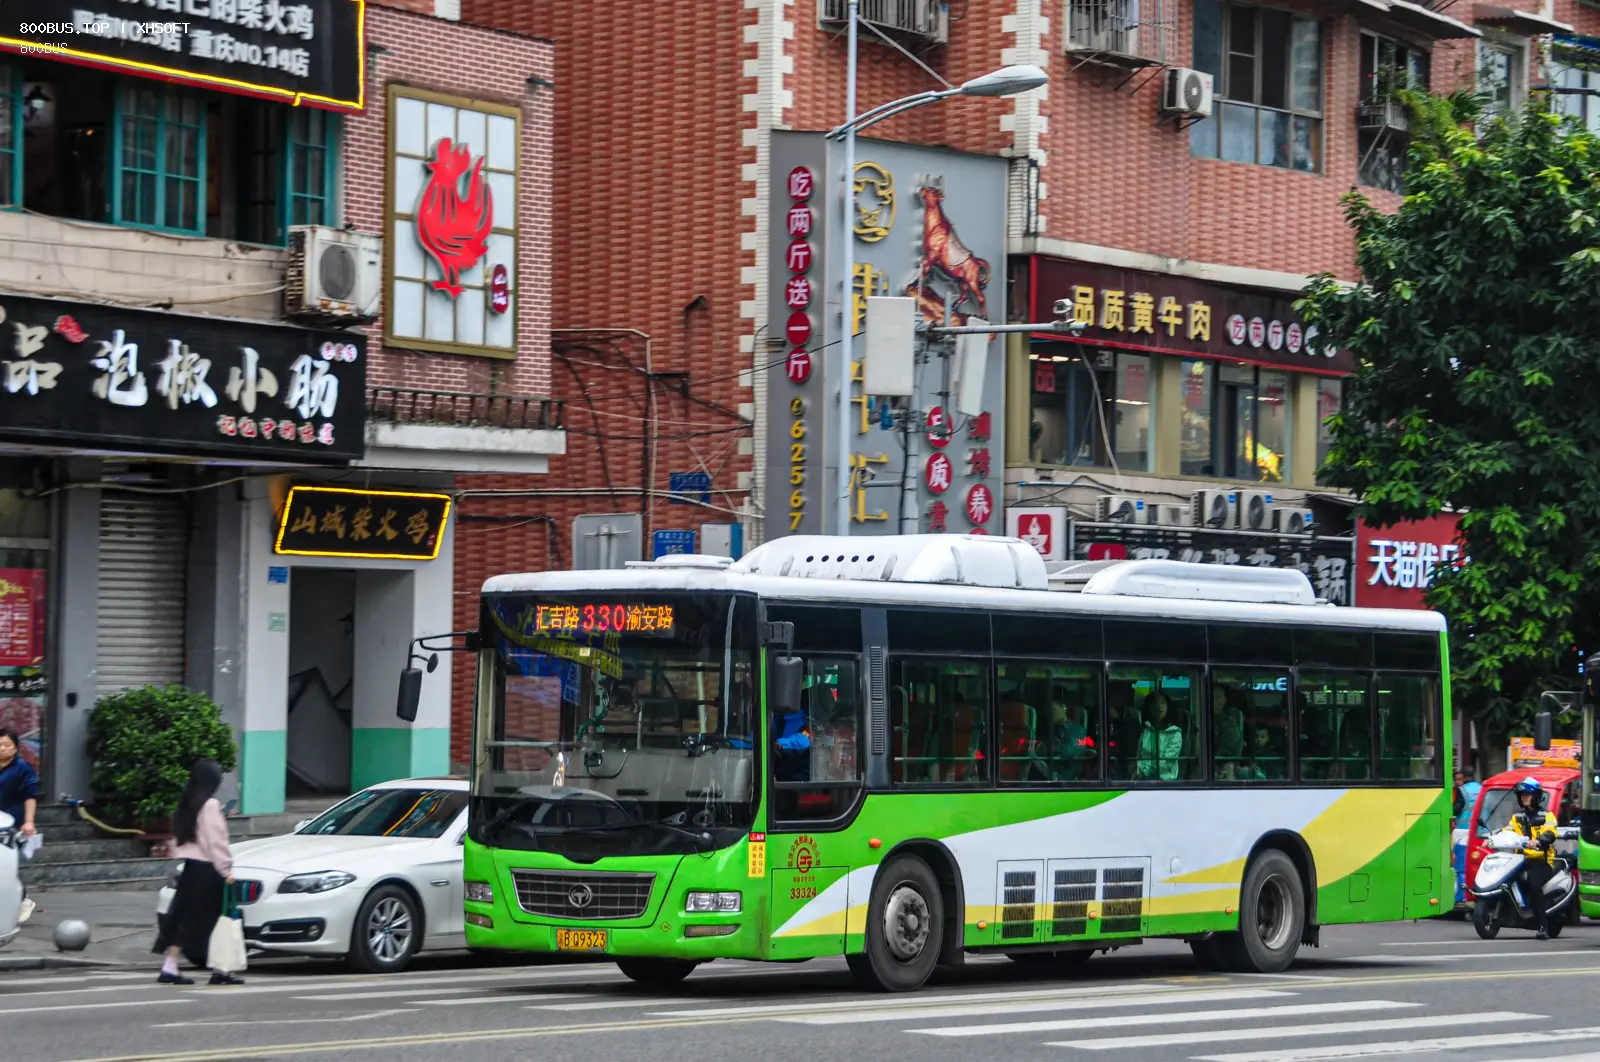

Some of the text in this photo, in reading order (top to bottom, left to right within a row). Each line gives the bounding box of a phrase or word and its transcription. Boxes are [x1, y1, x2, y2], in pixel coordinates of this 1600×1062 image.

[189, 29, 310, 78] 重庆NO.14店
[786, 166, 813, 383] 吃两斤送一斤
[1071, 285, 1212, 342] 品质黄牛肉
[290, 504, 430, 545] 山城柴火鸡
[536, 604, 674, 632] 汇吉路 330 渝安路
[790, 887, 817, 899] 33324
